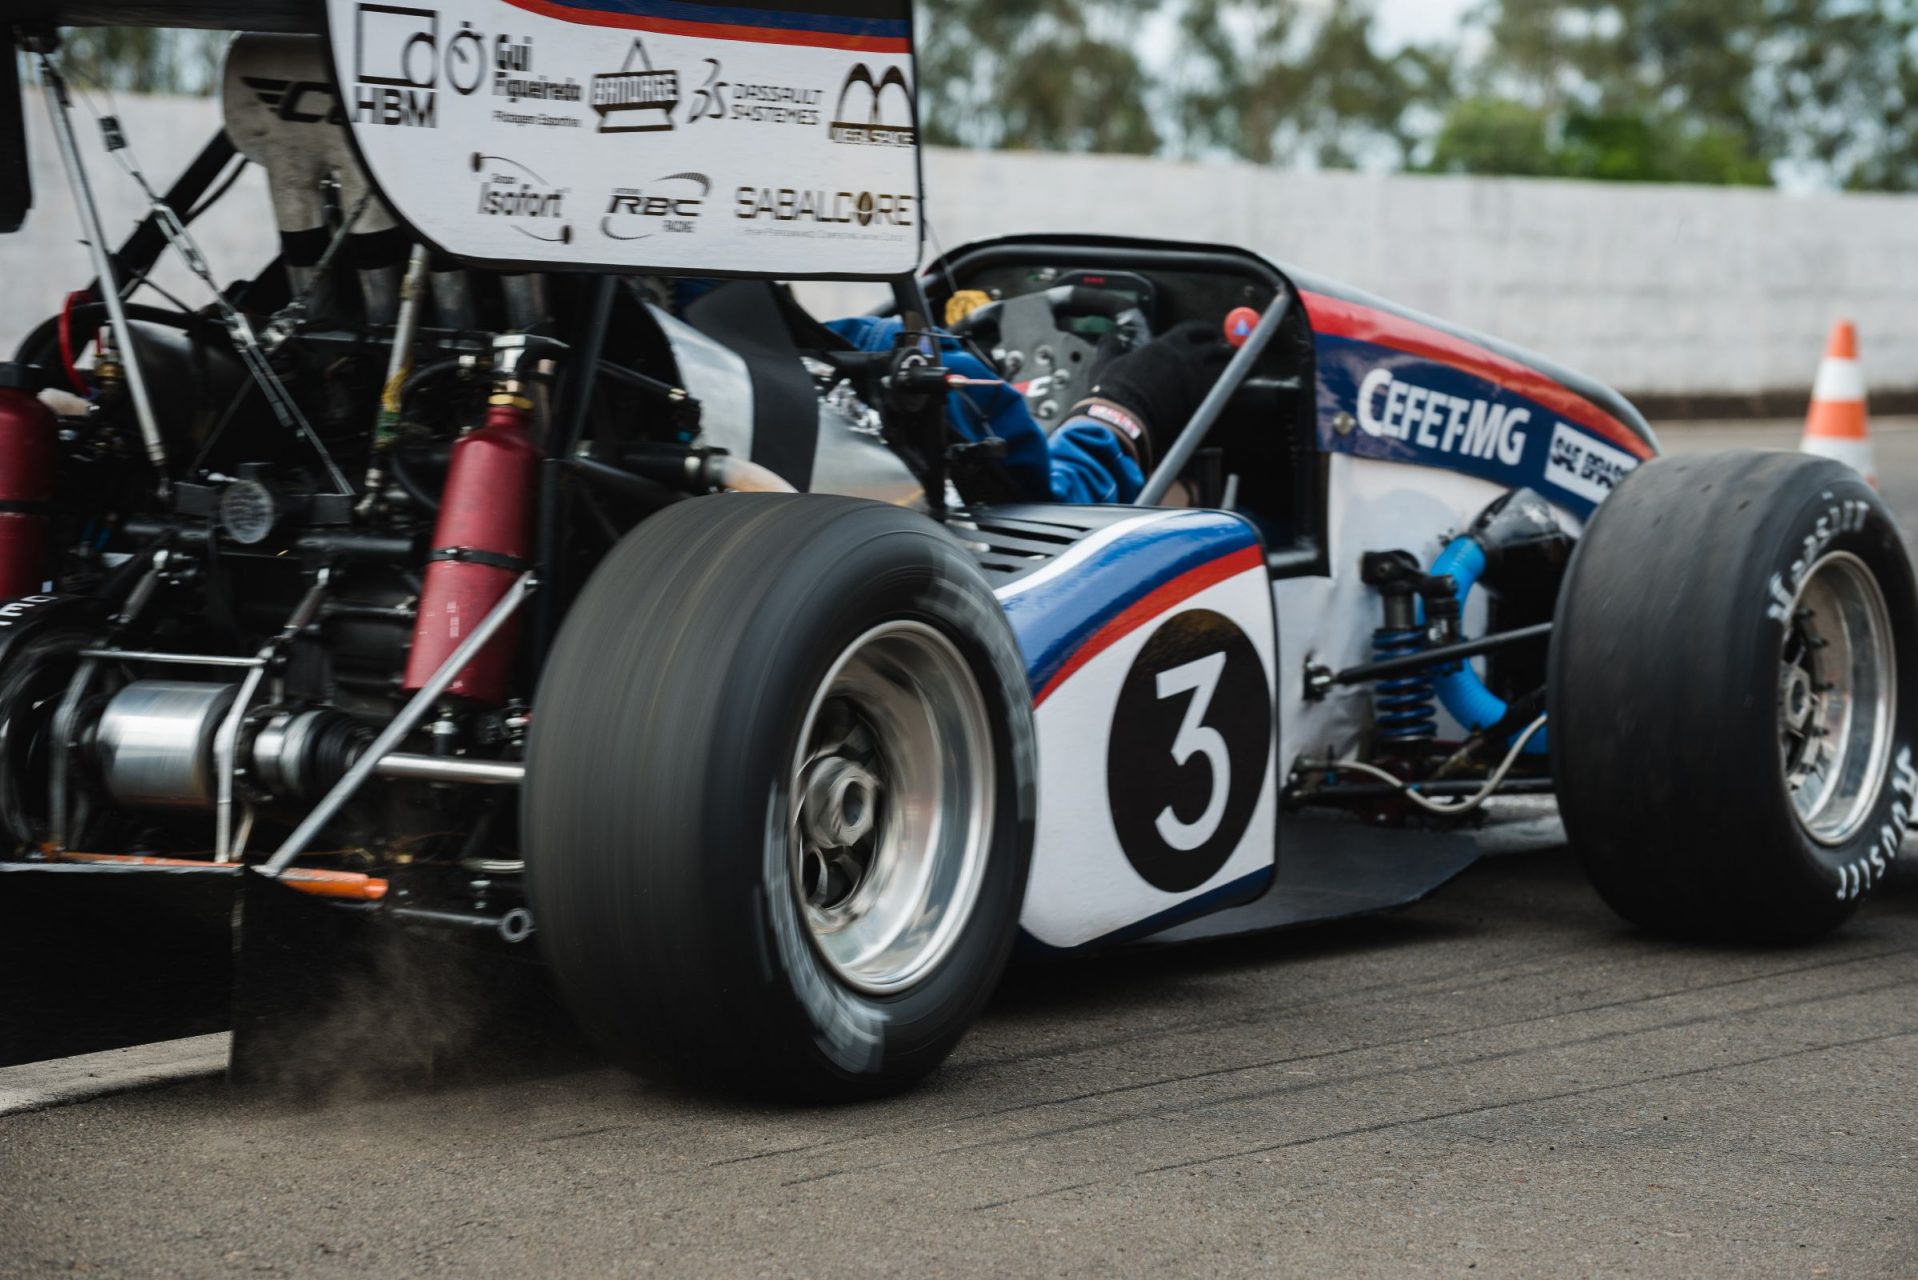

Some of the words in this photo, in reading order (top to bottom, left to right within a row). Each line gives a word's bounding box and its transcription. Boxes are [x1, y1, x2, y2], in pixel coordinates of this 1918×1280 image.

[495, 34, 533, 72] Gui
[493, 71, 582, 103] Figueiredo
[732, 83, 825, 106] DASSAULT
[352, 86, 438, 128] HBM
[478, 181, 563, 217] Isofort
[607, 194, 703, 217] RBC
[735, 186, 914, 226] SABALCORE
[1356, 368, 1531, 466] CEFET-MG
[1155, 651, 1232, 851] 3
